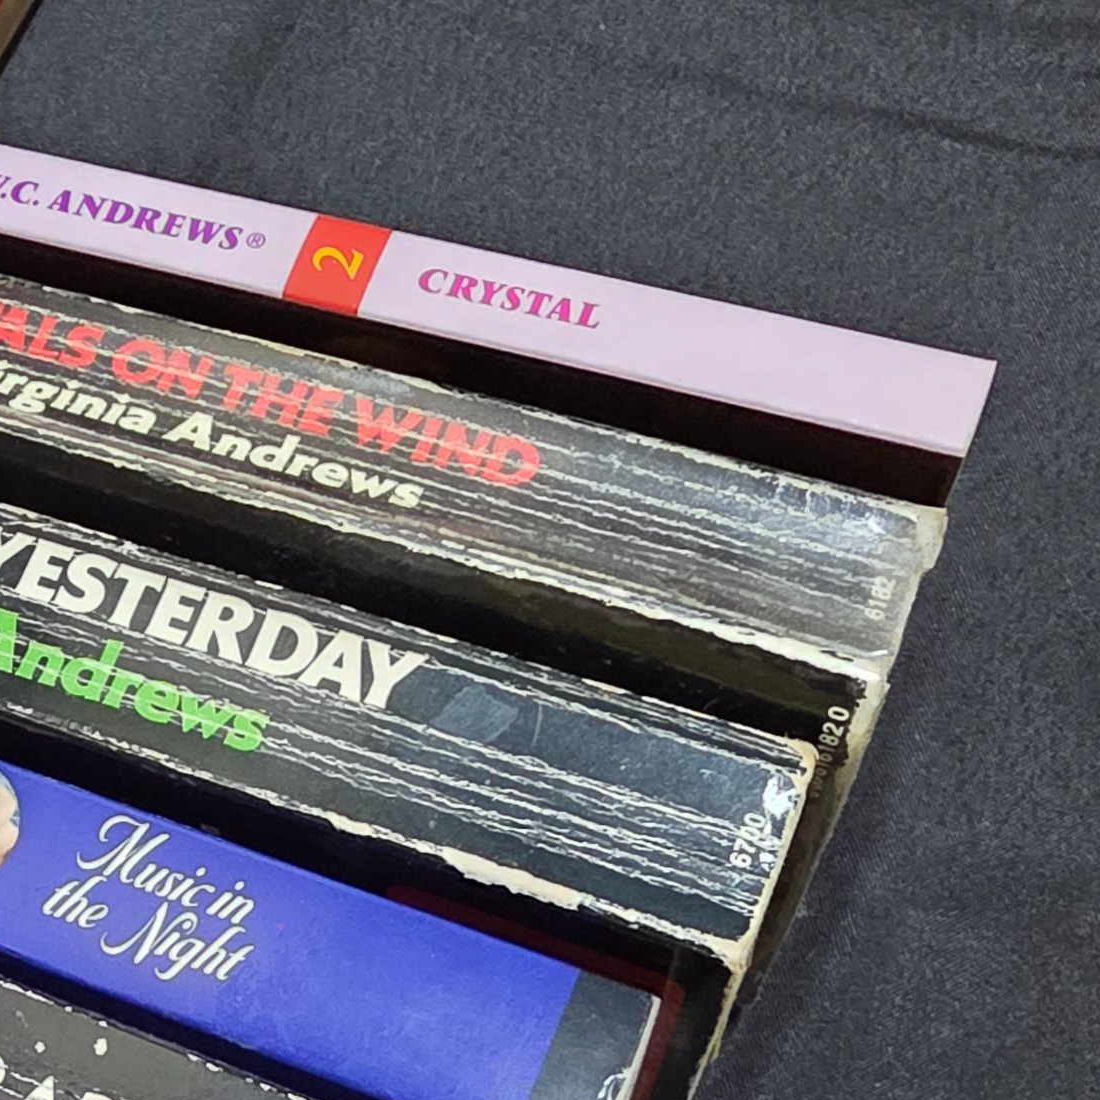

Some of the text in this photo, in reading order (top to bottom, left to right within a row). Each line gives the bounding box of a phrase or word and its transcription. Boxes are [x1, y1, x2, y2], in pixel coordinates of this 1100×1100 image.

[312, 245, 364, 279] 2
[418, 268, 601, 329] CRYSTAL
[111, 340, 216, 402] ON
[219, 364, 343, 433] THE
[354, 390, 541, 489] WIND
[164, 414, 424, 509] Andrews
[77, 814, 256, 926] Music in
[42, 879, 255, 983] the Night
